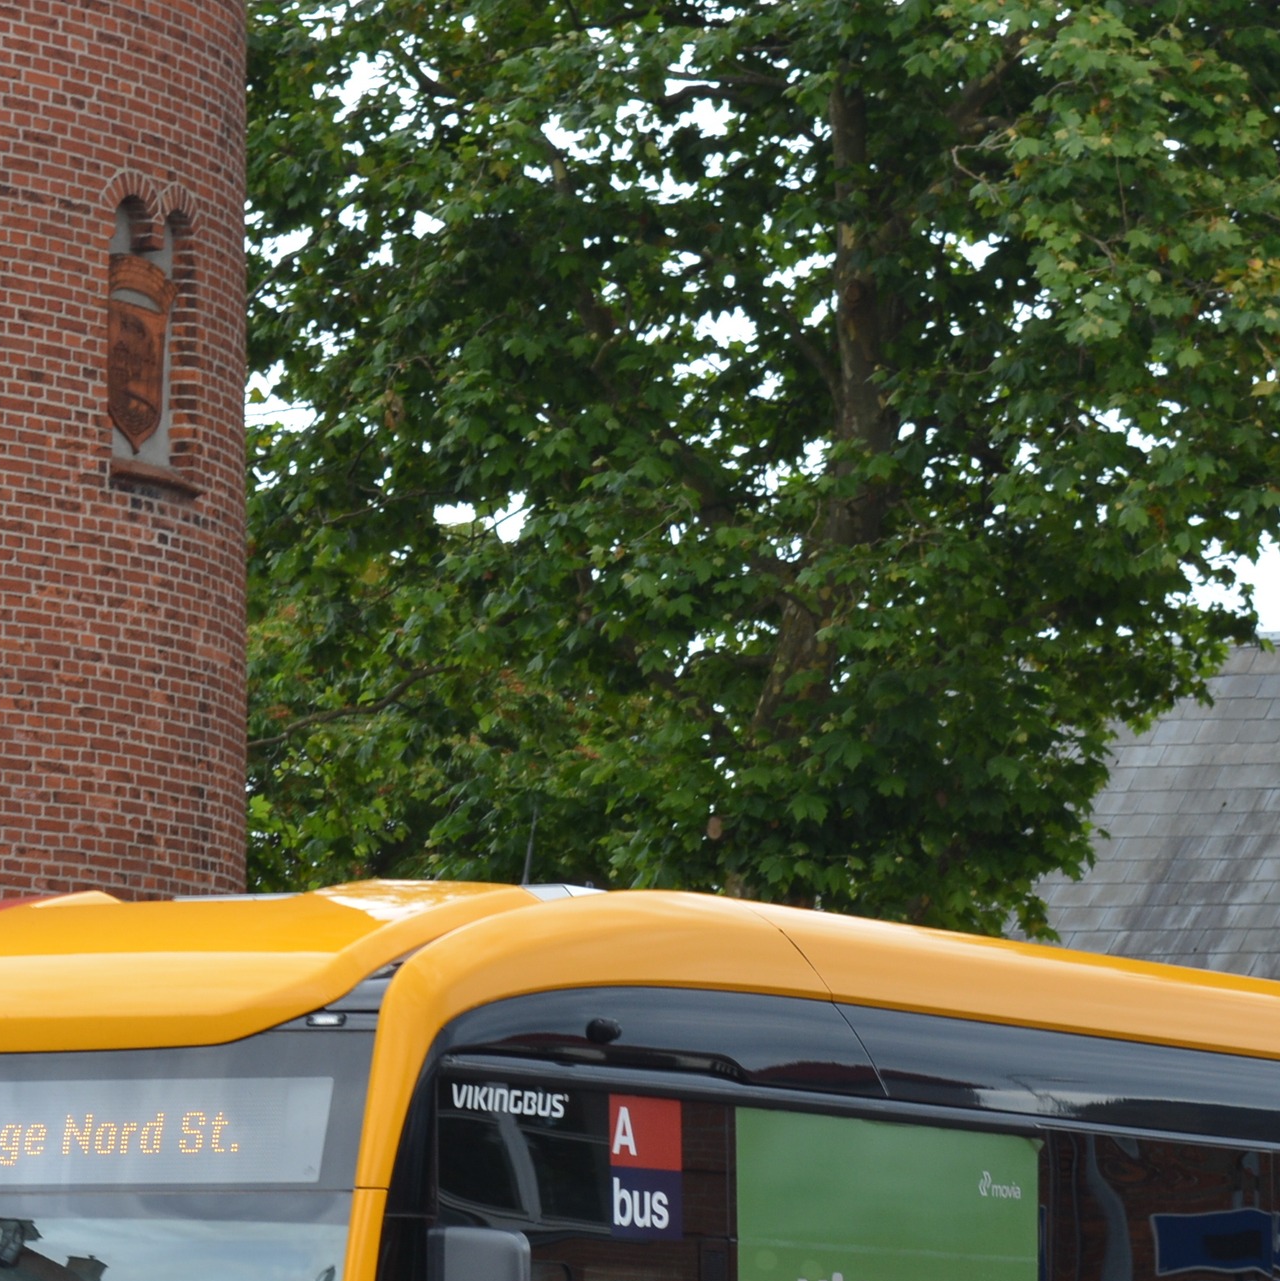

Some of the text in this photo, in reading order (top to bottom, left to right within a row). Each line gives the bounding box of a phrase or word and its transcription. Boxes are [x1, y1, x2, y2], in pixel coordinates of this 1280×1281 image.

[62, 1112, 164, 1154] Nord
[179, 1111, 239, 1153] St.
[612, 1106, 637, 1156] A
[613, 1177, 670, 1230] bus
[991, 1181, 1021, 1199] movia
